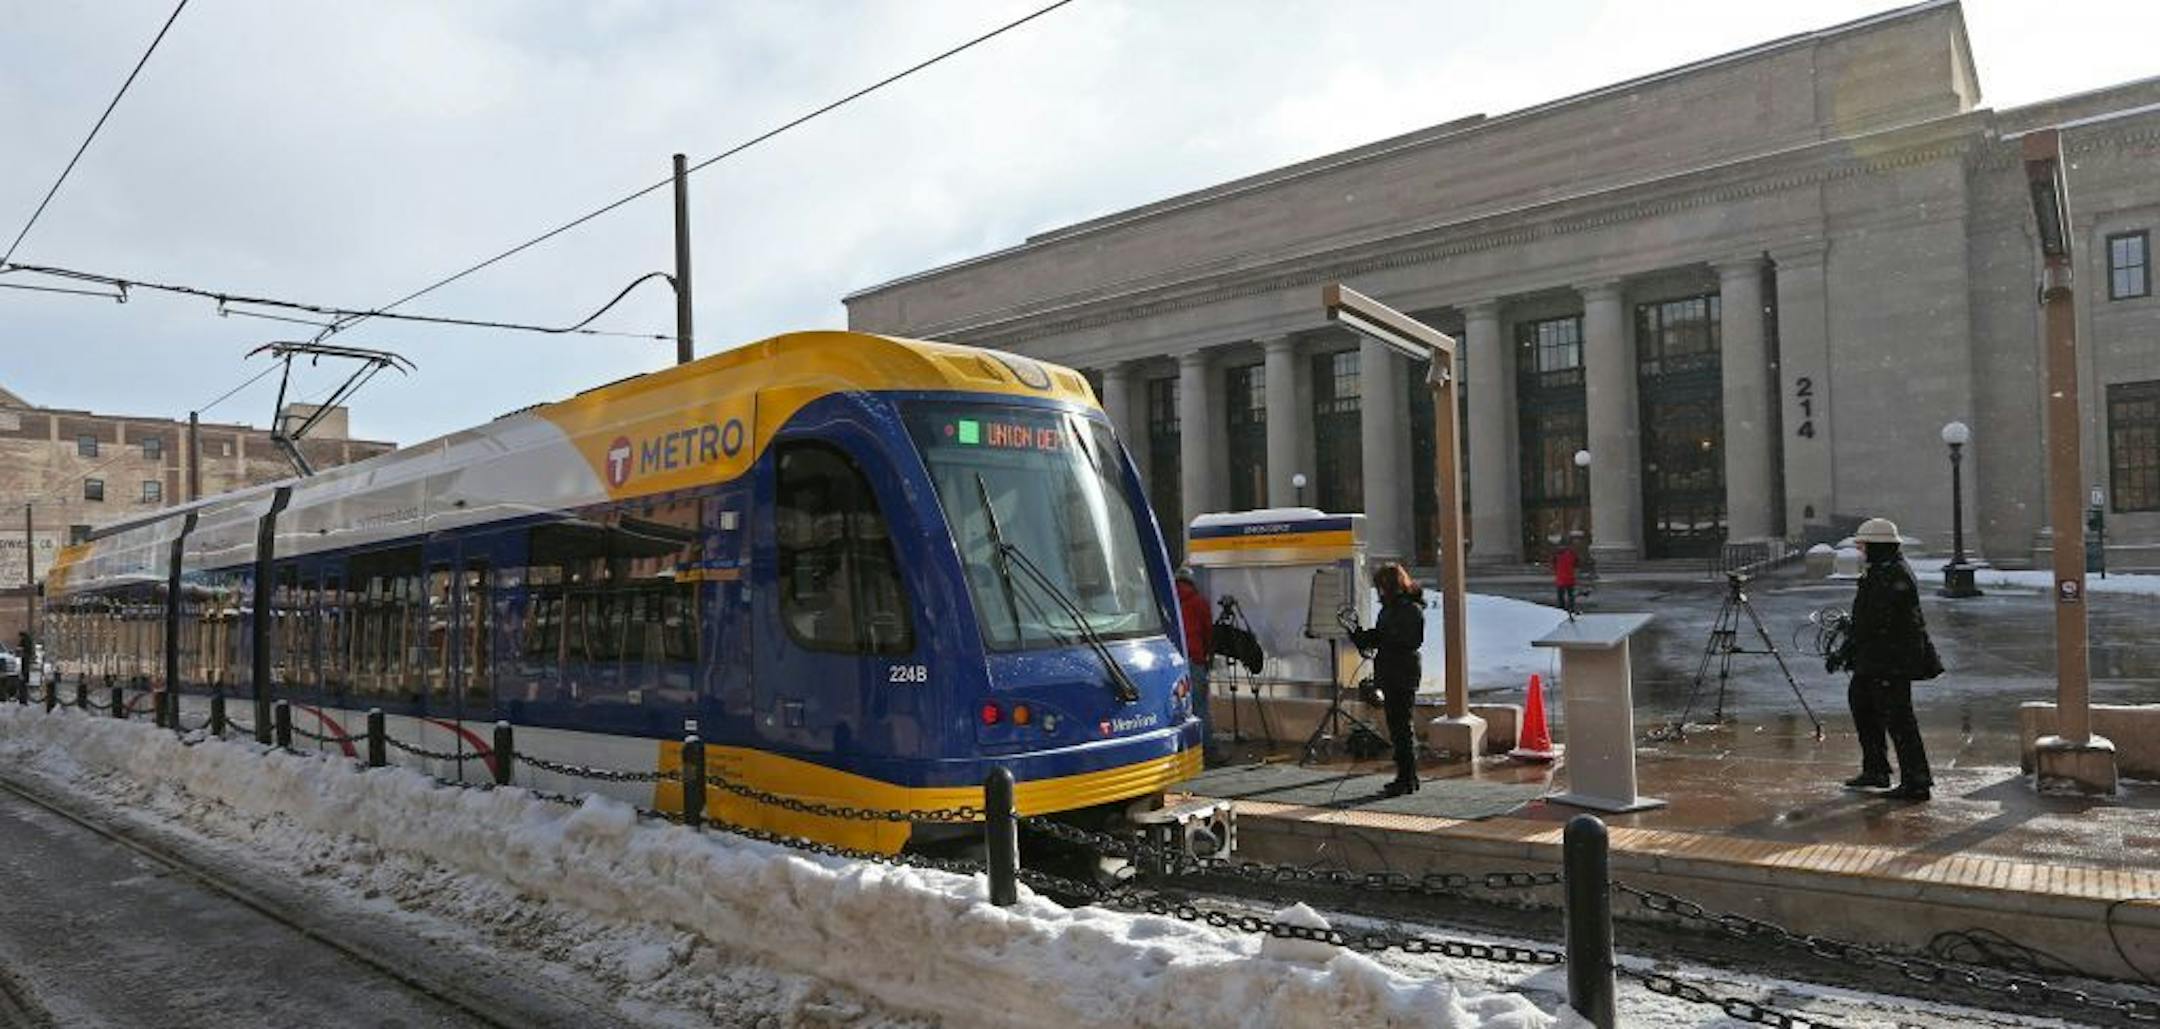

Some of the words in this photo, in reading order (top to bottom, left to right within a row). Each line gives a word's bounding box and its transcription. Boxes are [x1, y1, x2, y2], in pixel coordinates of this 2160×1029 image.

[1796, 377, 1816, 438] 214
[641, 419, 743, 474] METRO
[988, 422, 1032, 447] UNION
[889, 665, 928, 682] 224B
